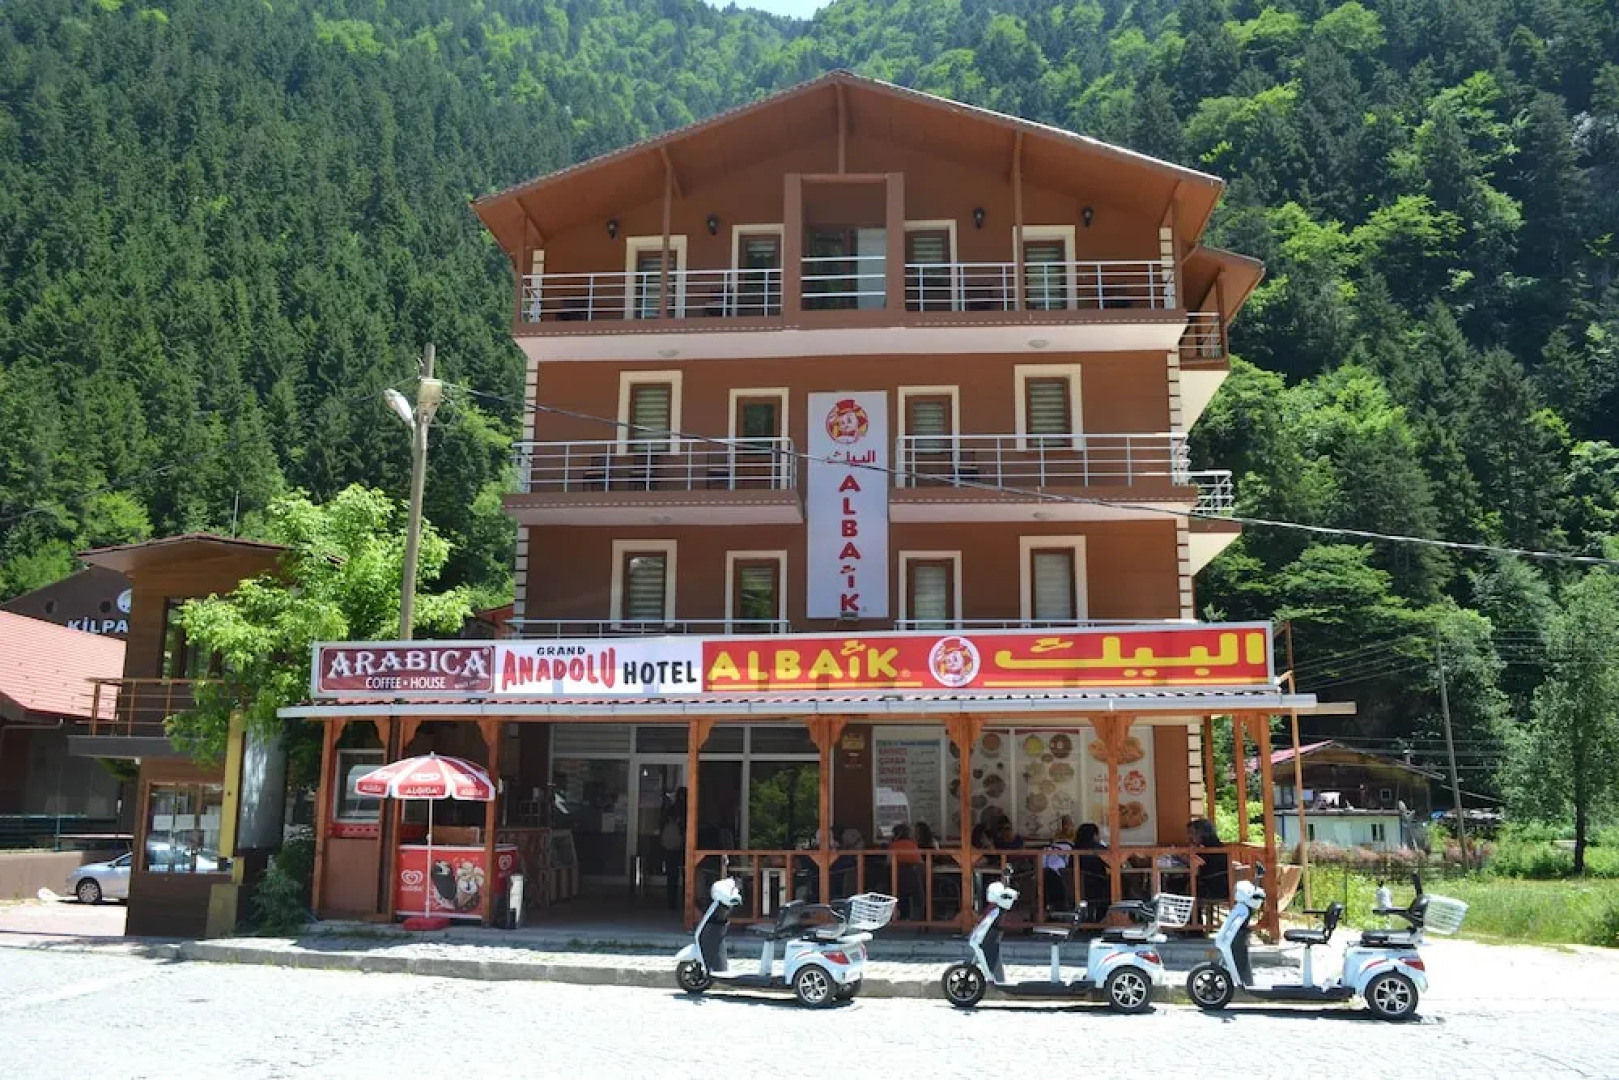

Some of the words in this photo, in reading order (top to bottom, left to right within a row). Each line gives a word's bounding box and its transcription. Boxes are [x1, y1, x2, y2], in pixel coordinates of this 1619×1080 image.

[536, 646, 586, 656] GRAND
[327, 649, 488, 679] ARABICA
[501, 648, 616, 690] ANADOLU
[623, 660, 698, 685] HOTEL
[365, 676, 401, 689] COFFEE
[410, 676, 446, 689] HOUSE
